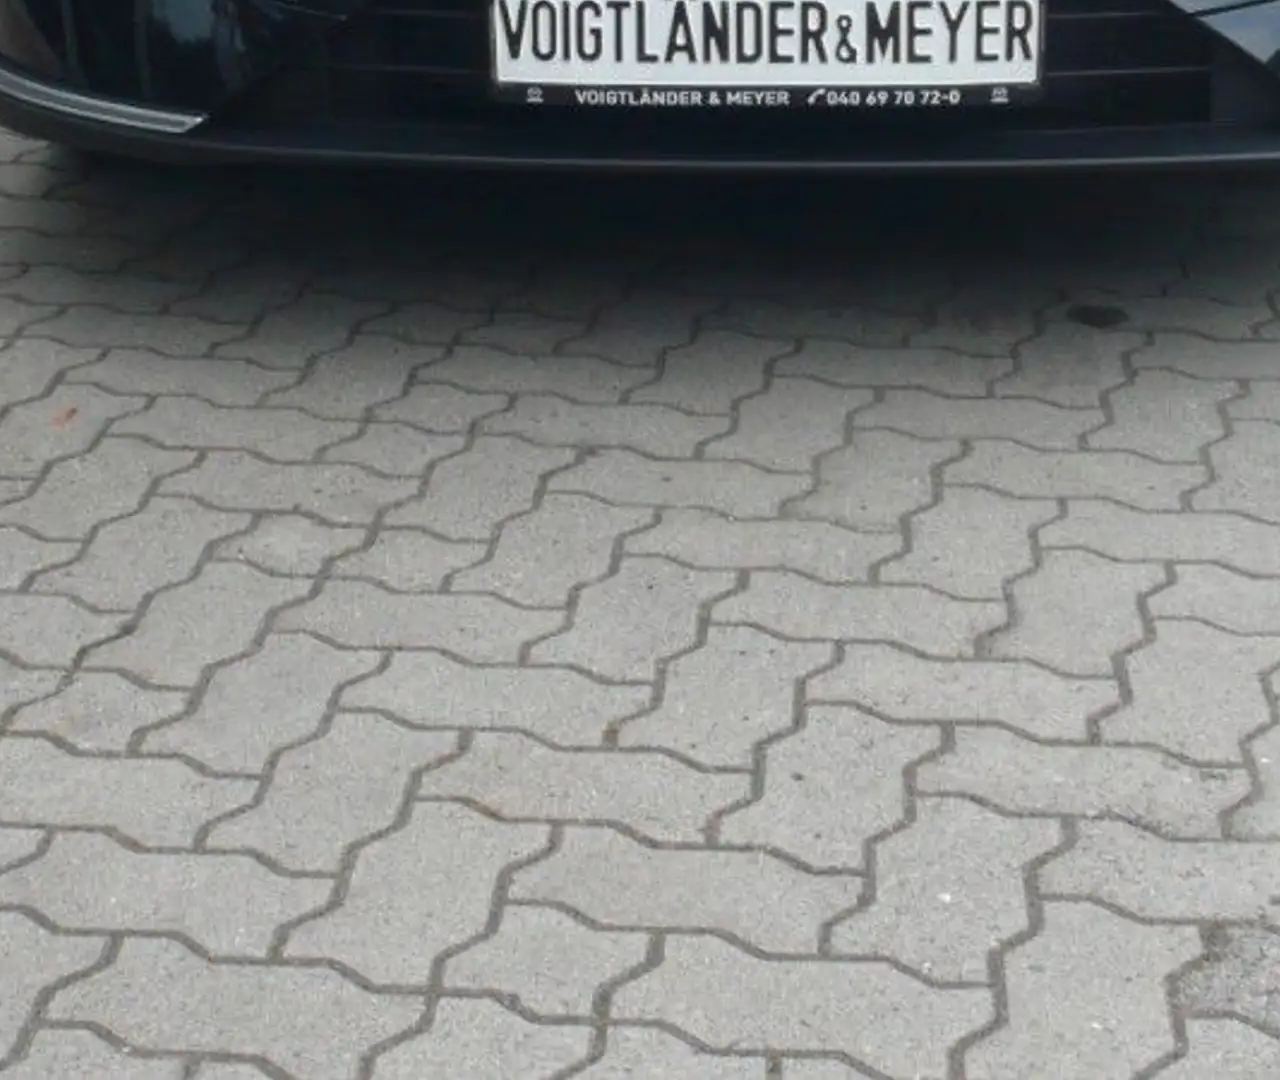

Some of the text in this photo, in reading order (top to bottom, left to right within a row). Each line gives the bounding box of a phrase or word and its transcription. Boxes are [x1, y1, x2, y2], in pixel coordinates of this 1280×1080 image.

[575, 87, 702, 105] VOIGTLÄNDER
[708, 91, 721, 105] &
[726, 91, 790, 105] MEYER
[826, 91, 860, 105] 040
[866, 91, 888, 105] 69
[920, 89, 960, 104] 72-0
